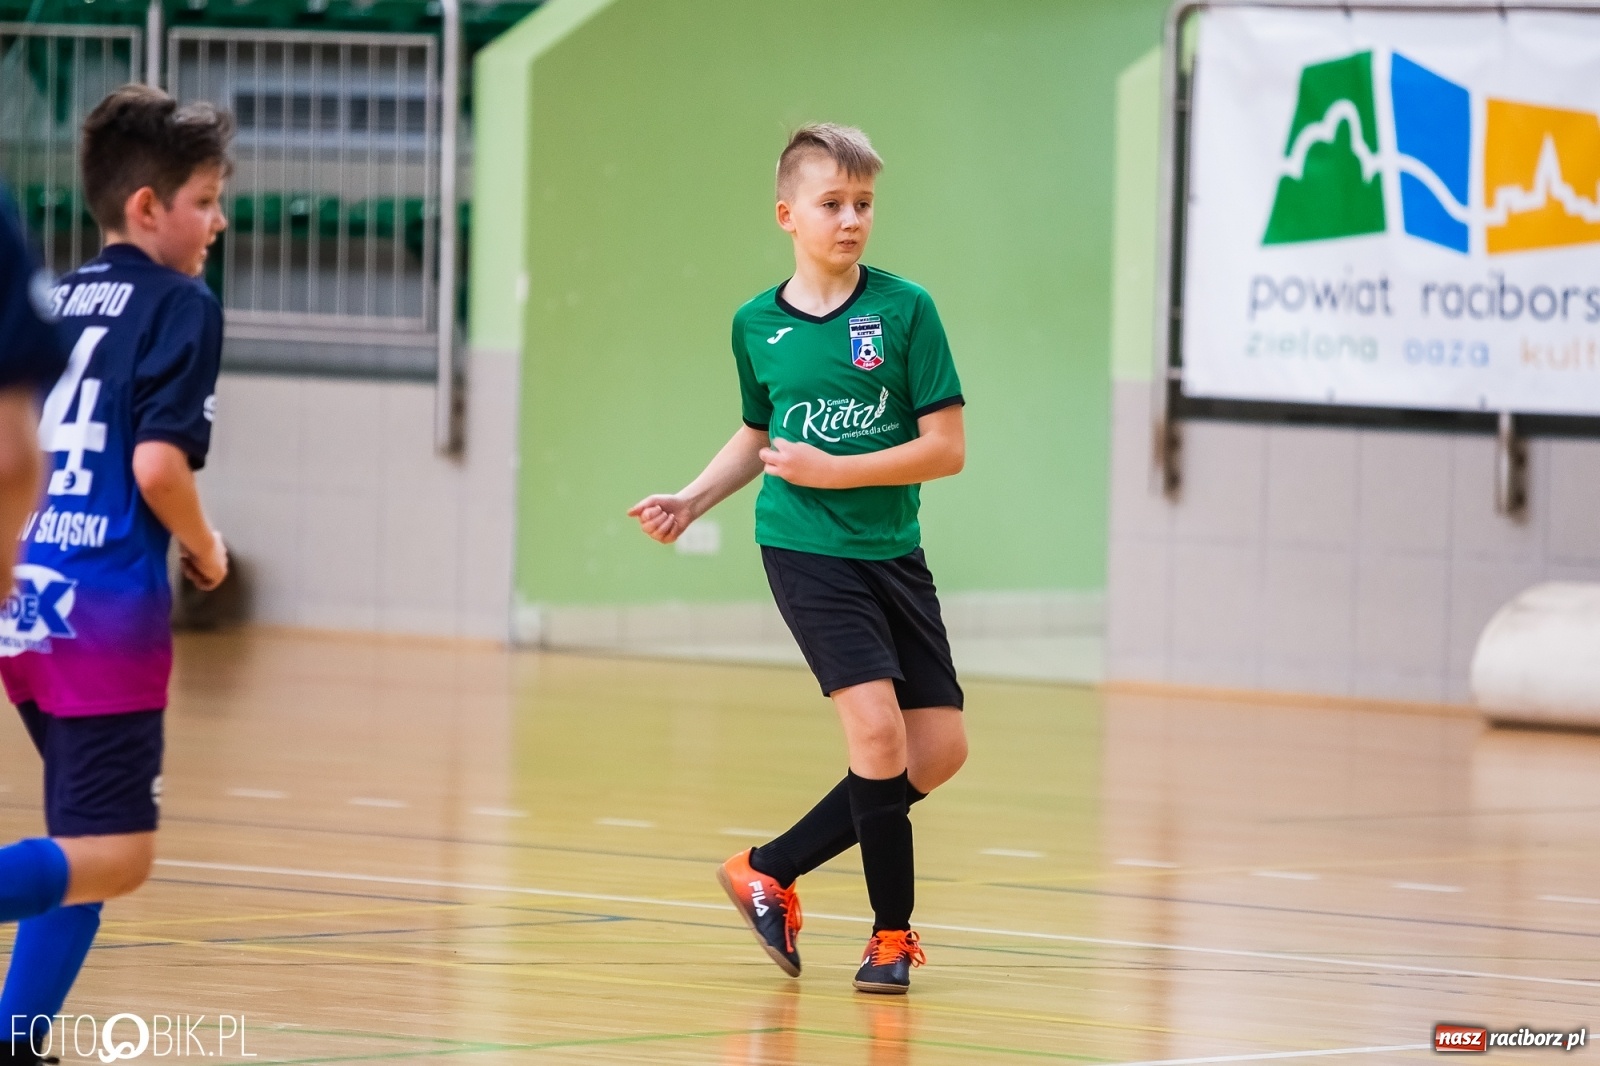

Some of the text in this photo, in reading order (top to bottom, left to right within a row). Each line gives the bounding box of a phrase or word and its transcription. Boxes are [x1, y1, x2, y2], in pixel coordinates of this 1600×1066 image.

[62, 281, 134, 317] RAPID
[1249, 267, 1391, 321] powiat
[1245, 325, 1379, 364] zielona
[1403, 336, 1490, 367] oaza
[38, 325, 108, 496] 4
[783, 398, 876, 443] Kietrz
[826, 398, 850, 407] Gmina
[841, 421, 900, 440] miejsce dla Ciebie
[34, 504, 109, 552] ŚLĄSKI
[749, 881, 769, 917] FILA
